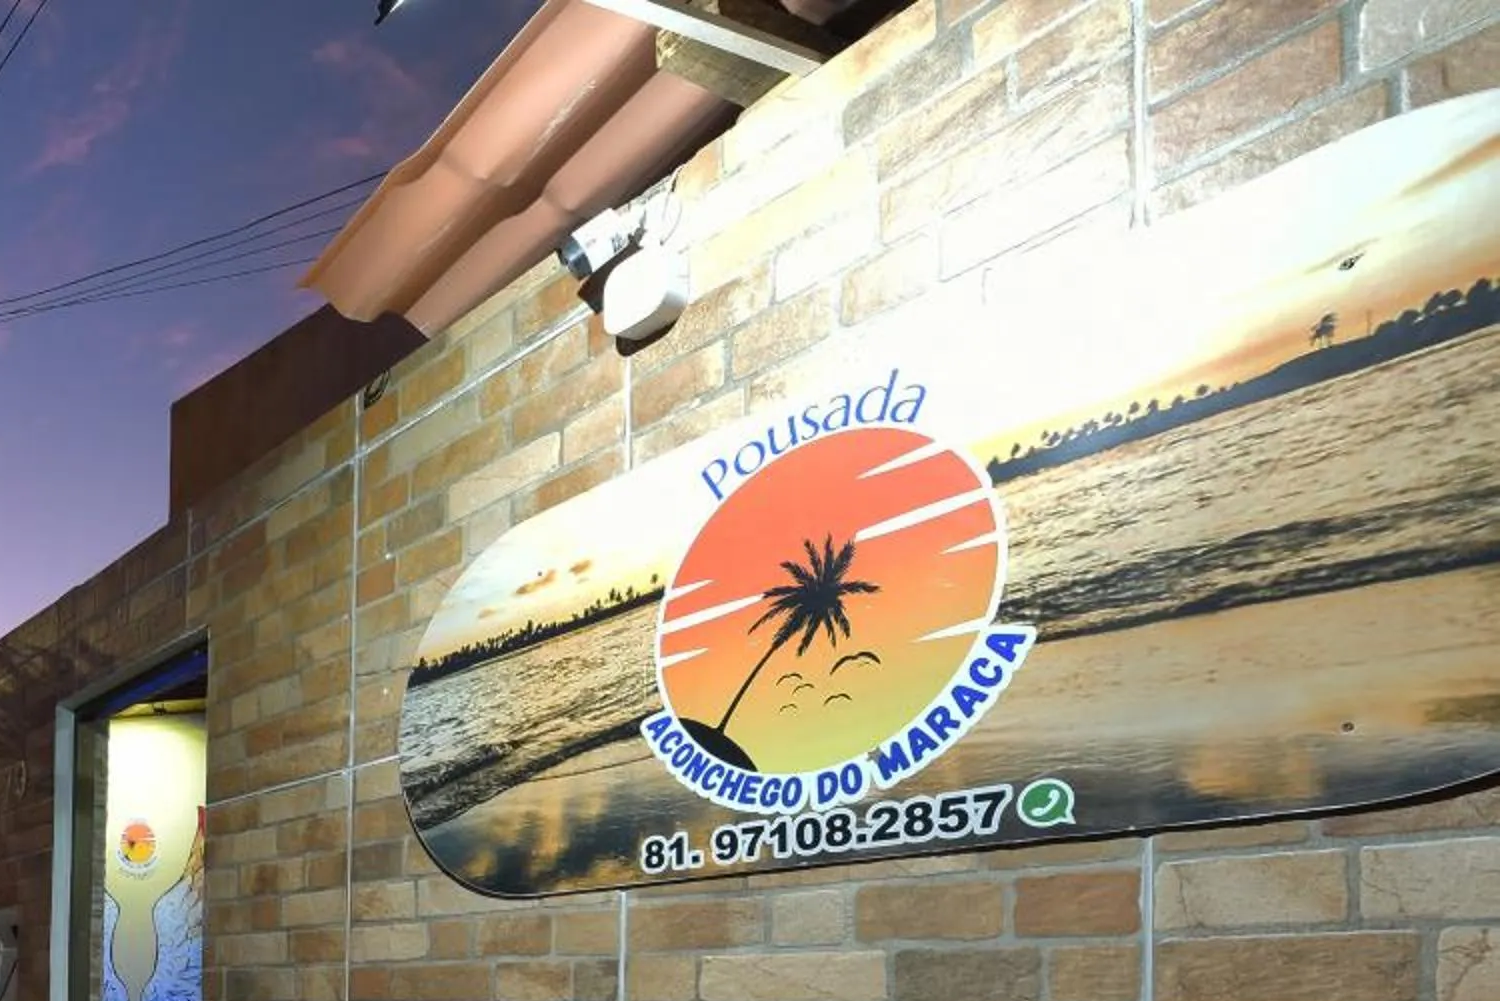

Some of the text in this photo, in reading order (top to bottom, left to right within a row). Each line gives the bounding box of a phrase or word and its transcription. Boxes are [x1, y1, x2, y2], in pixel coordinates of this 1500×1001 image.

[701, 367, 927, 501] Pousada
[645, 633, 1028, 808] ACONCHEGO DO MARACA
[644, 790, 1006, 869] 81. 97108.2857
